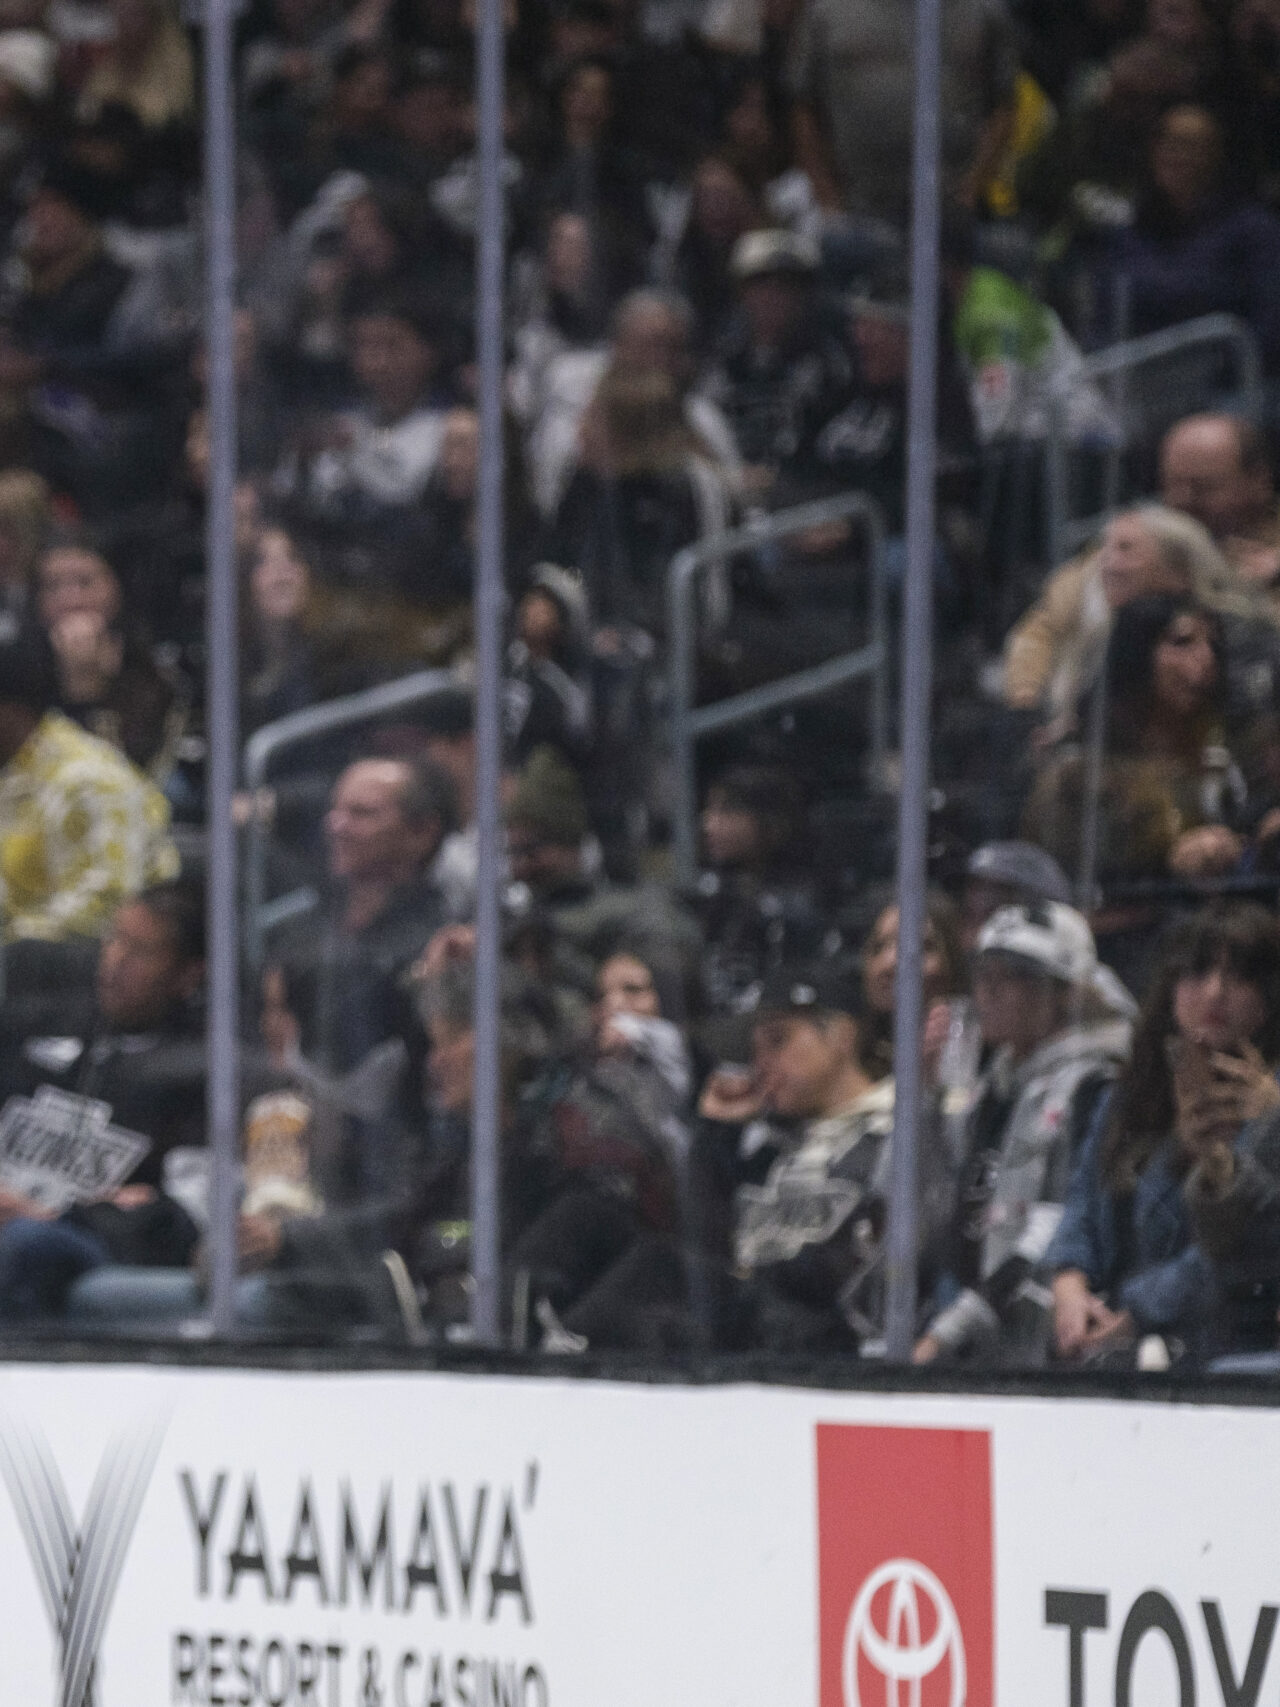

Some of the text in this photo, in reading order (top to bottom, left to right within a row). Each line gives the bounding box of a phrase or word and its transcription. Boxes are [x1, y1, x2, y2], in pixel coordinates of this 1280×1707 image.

[172, 1630, 550, 1707] RESORT & CASINO
